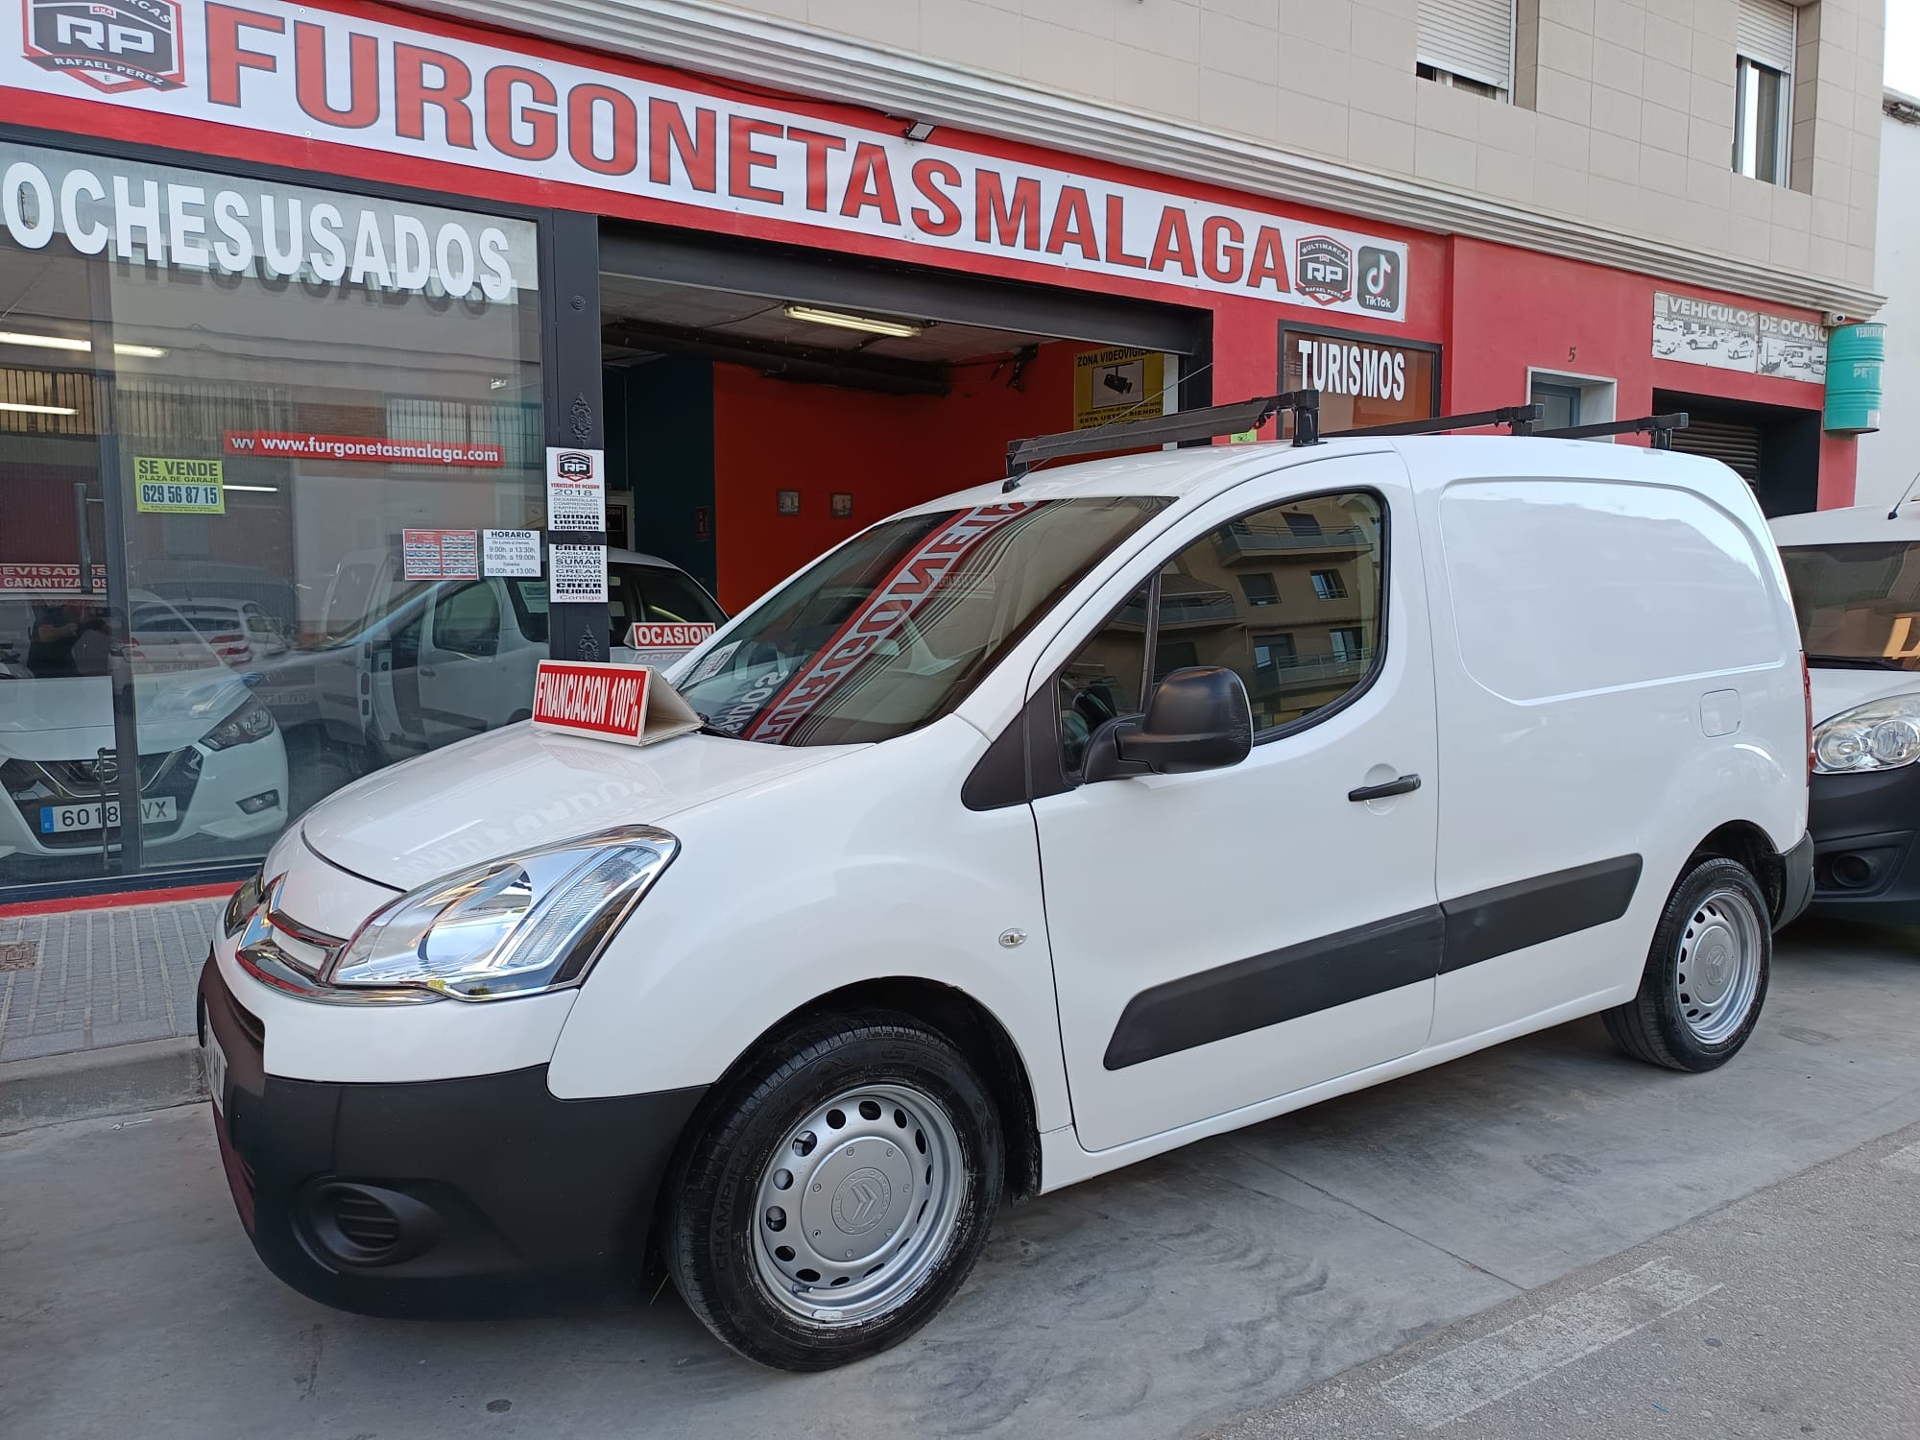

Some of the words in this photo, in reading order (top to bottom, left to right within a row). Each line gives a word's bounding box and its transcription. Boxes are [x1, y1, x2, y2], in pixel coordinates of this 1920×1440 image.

[56, 13, 155, 54] RP
[54, 57, 112, 71] RAFAEL
[116, 65, 164, 87] PEREZ
[1306, 261, 1343, 283] RP
[1365, 294, 1392, 308] TikTok
[1668, 297, 1756, 327] VEHICULOS
[1760, 314, 1778, 333] DE
[1780, 319, 1829, 342] OCASIO
[1077, 353, 1099, 367] ZONA
[1568, 345, 1577, 363] 5
[1298, 339, 1406, 401] TURISMOS
[1129, 408, 1161, 417] SIENDO
[262, 436, 499, 464] www.furgonetasmalaga.com
[139, 460, 160, 475] SE
[164, 461, 219, 477] VENDE
[564, 462, 588, 472] RP
[139, 474, 168, 482] PLAZA
[142, 485, 165, 503] 629
[168, 486, 182, 503] 56
[185, 487, 200, 504] 87
[203, 487, 218, 504] 15
[554, 488, 593, 496] 2018
[491, 531, 532, 539] HORARIO
[0, 566, 107, 576] EVISADS
[3, 577, 108, 588] GARANTIZAOS
[637, 626, 712, 645] OCASION
[535, 672, 611, 725] FINANCIACION
[608, 677, 641, 732] 100%
[62, 806, 119, 828] 6018
[141, 800, 168, 820] VX
